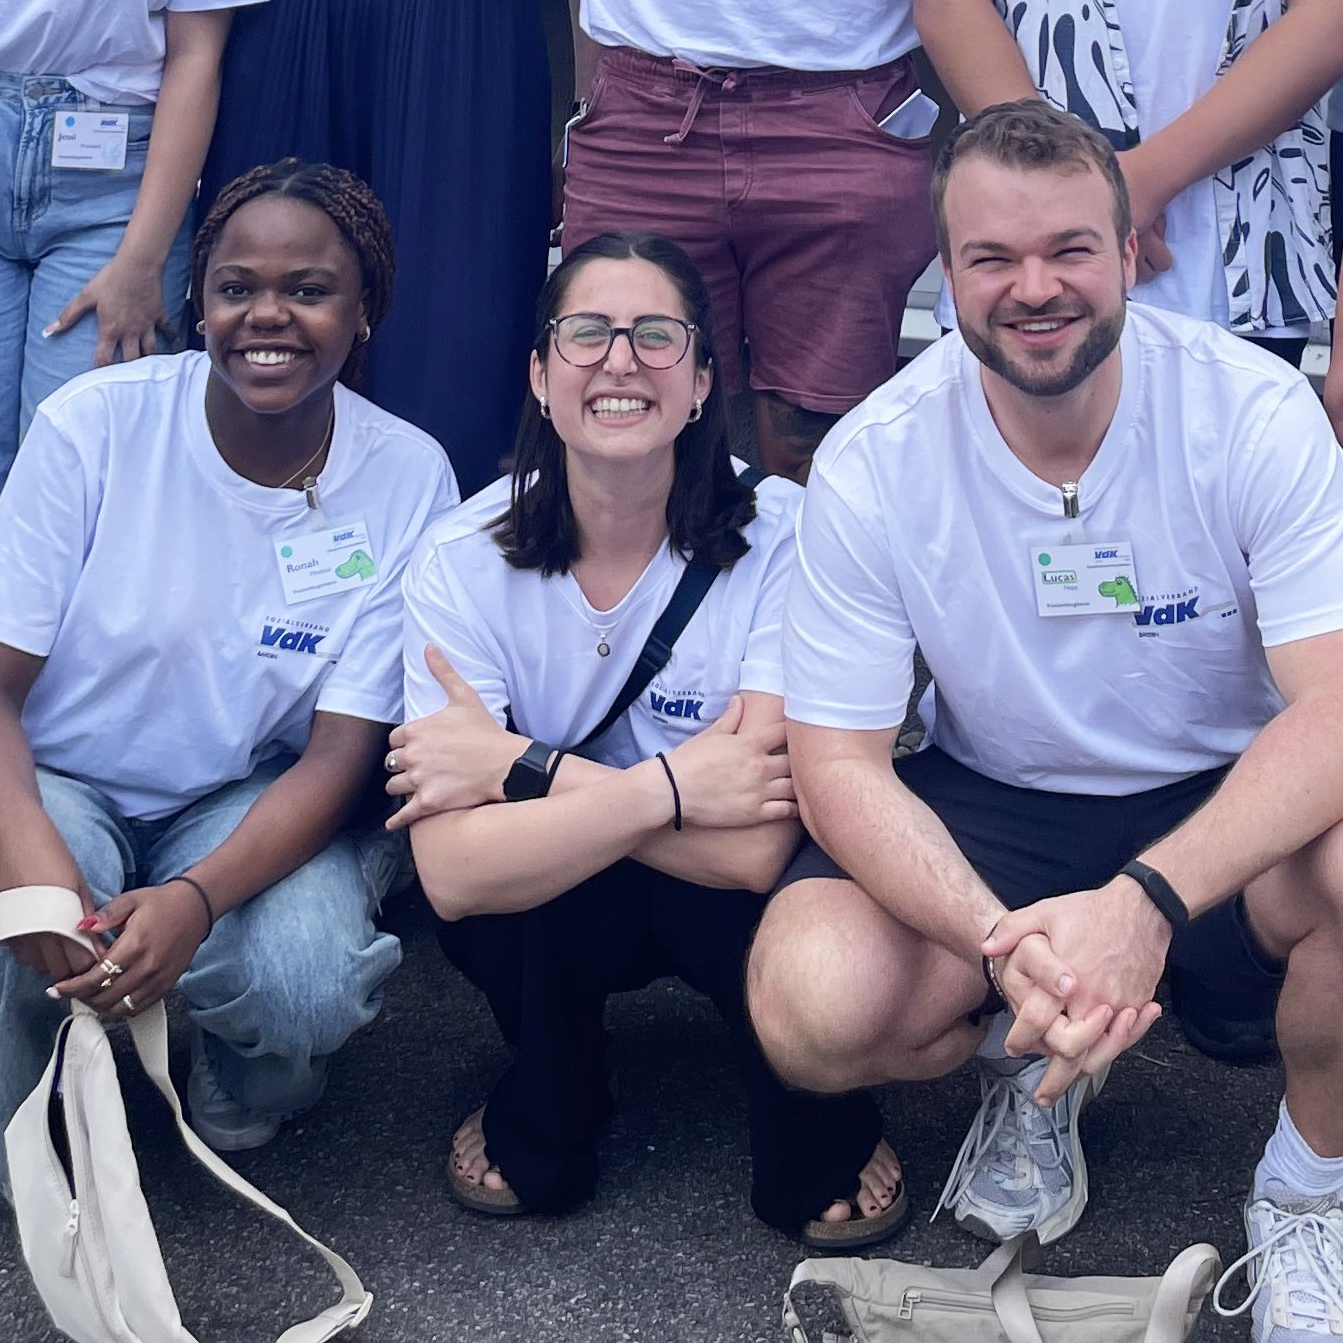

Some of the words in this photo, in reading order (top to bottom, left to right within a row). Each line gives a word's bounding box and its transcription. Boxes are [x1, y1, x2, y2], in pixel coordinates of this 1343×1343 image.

[1094, 549, 1119, 560] VdK
[1043, 572, 1076, 583] Lucas
[1133, 596, 1199, 626] VdK
[260, 624, 326, 654] VdK
[649, 690, 704, 721] VdK
